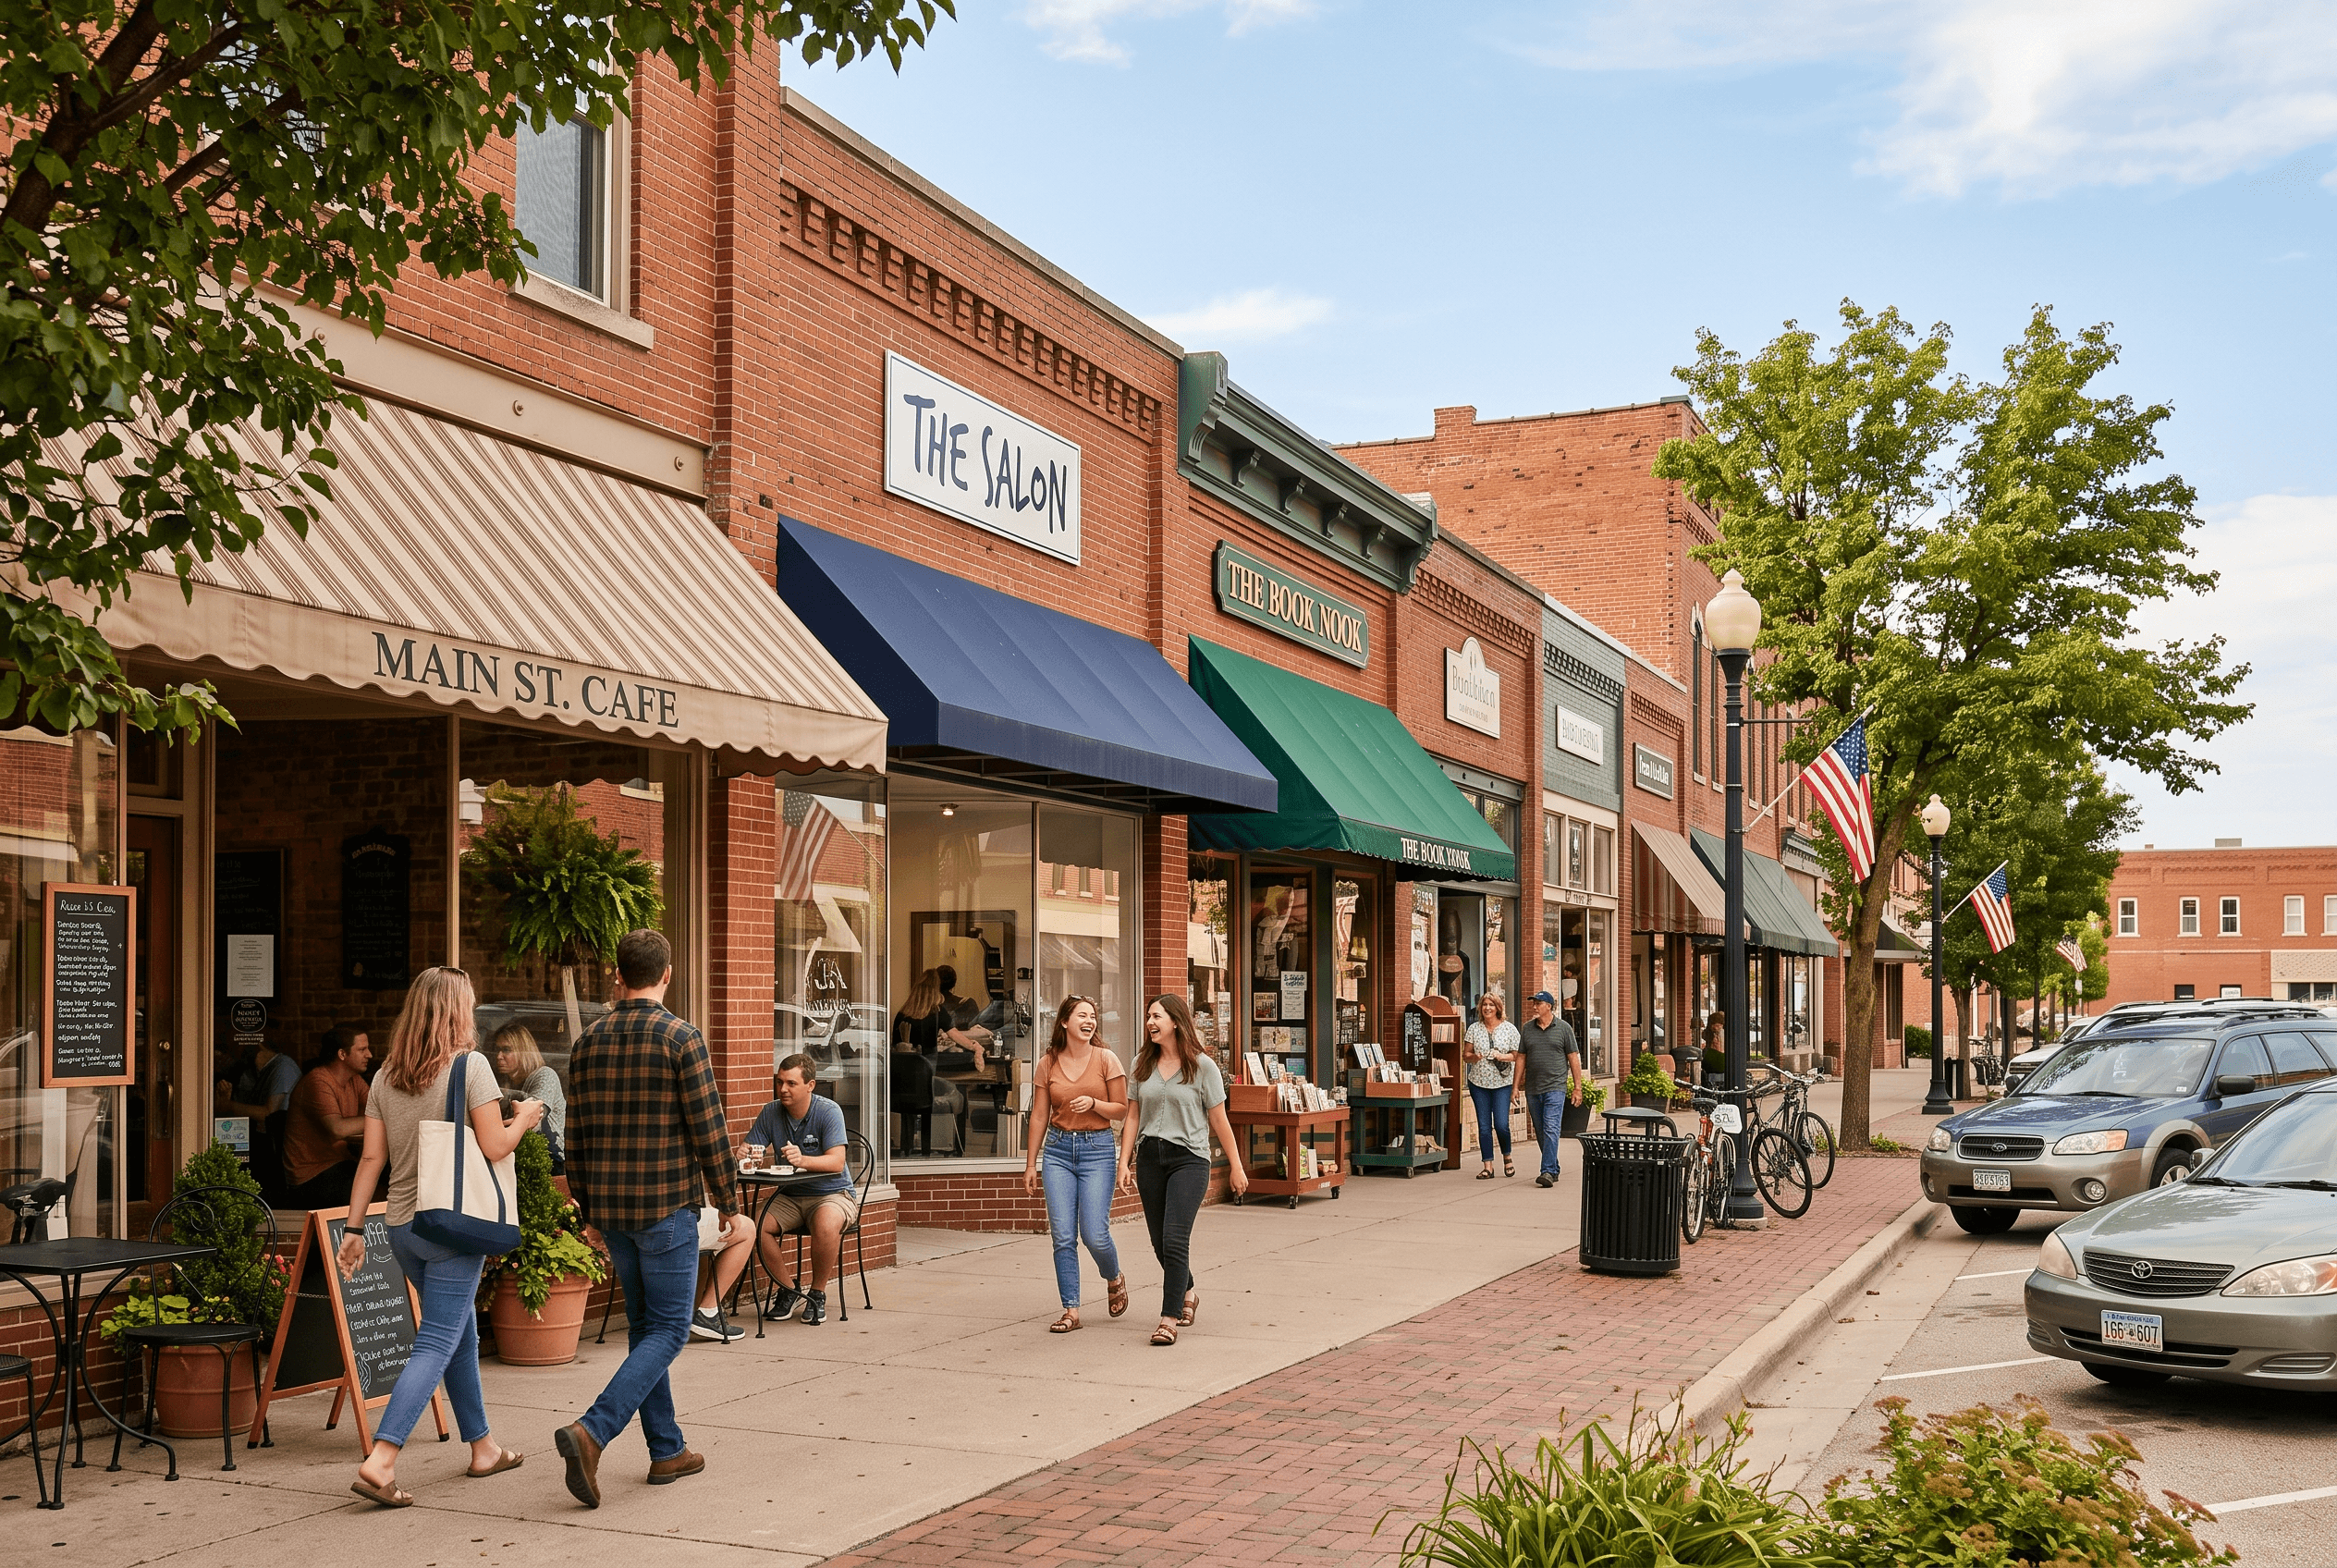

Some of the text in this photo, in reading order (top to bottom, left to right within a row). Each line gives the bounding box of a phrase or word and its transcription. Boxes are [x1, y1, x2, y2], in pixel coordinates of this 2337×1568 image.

[903, 394, 1067, 534] THE SALON
[1228, 559, 1363, 654] THE BOOK NOOK
[372, 631, 679, 728] MAIN ST. CAFE
[1401, 837, 1419, 861] THE
[1420, 841, 1446, 866] BOOK
[2104, 1320, 2124, 1339] 166
[2137, 1324, 2159, 1344] 607
